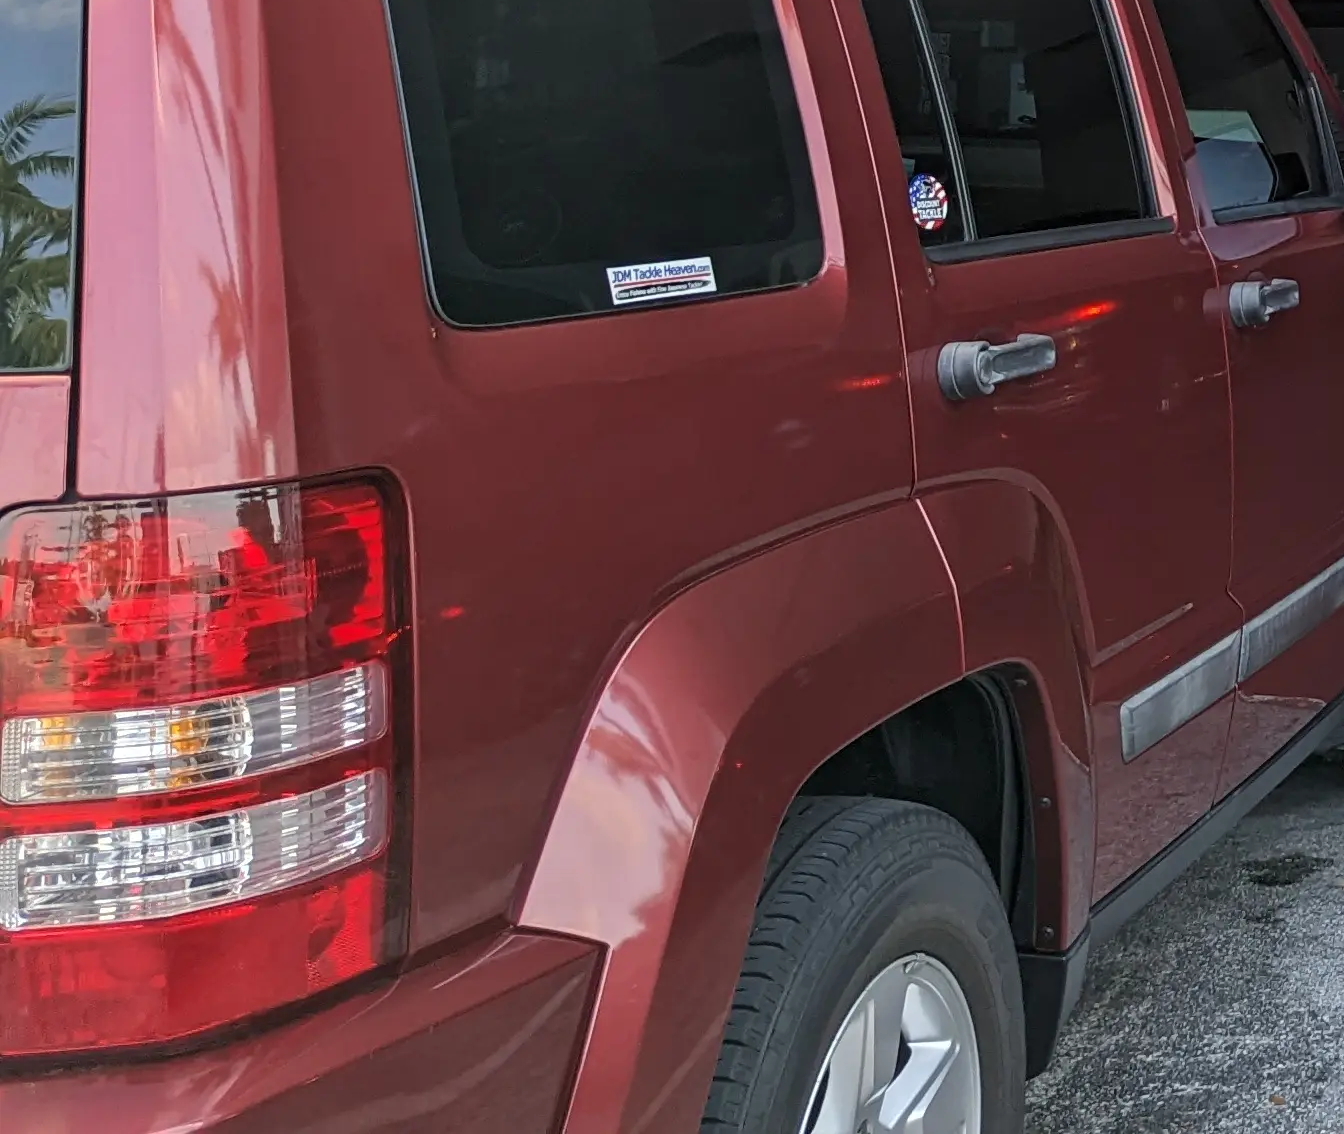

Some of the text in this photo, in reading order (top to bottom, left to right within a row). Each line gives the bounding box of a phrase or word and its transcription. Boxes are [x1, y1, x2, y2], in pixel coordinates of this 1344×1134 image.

[918, 208, 943, 220] TACKLE
[612, 263, 711, 283] JDM Tackle Heaven.com
